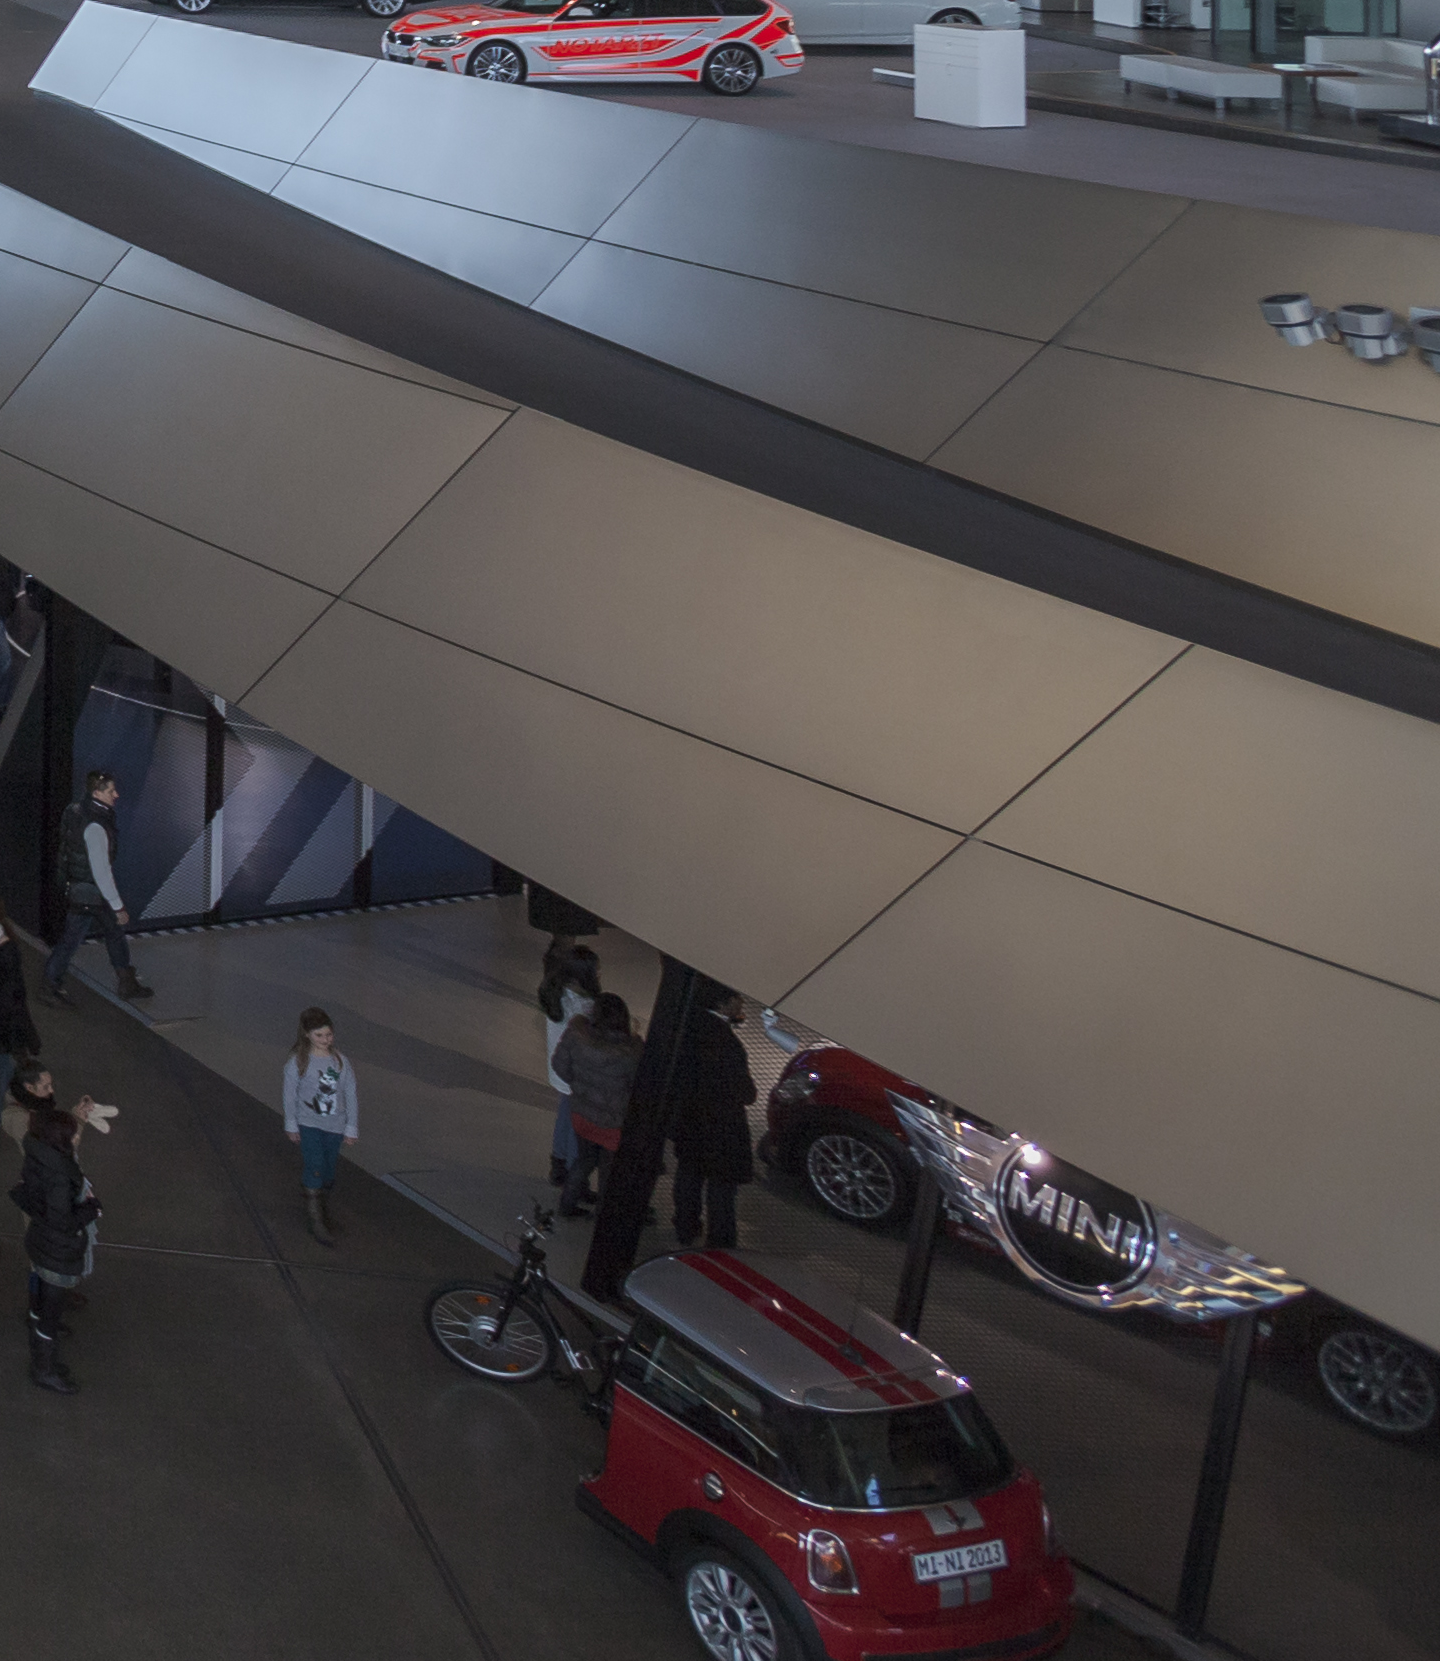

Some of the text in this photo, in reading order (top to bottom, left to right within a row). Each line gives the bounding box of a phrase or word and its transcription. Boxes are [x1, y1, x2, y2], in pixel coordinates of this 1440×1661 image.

[552, 33, 666, 54] NOTARZT
[1007, 1169, 1142, 1264] MINI
[967, 1543, 1001, 1568] 2013
